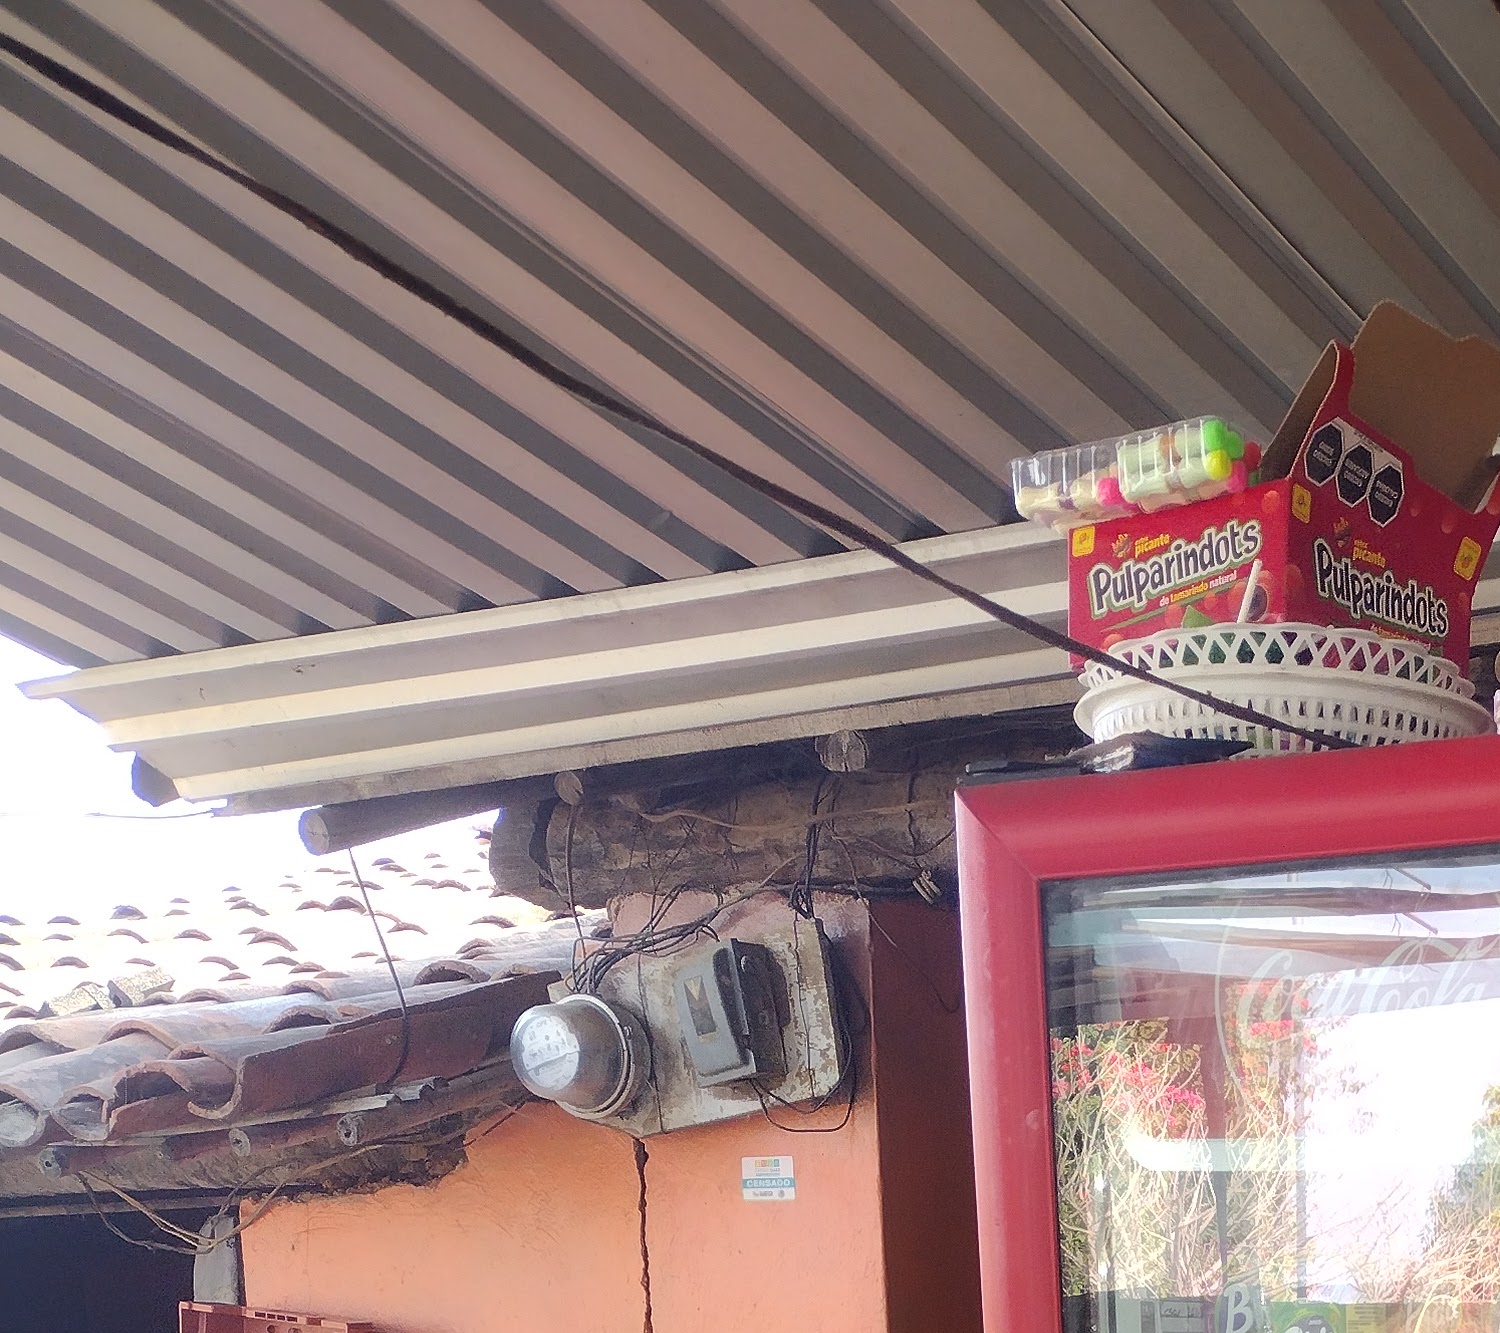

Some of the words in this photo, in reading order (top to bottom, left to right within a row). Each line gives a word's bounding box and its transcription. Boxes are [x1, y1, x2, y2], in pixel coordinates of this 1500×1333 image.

[1089, 520, 1262, 614] Pulparindots
[1313, 538, 1448, 638] Pulparindots
[746, 1178, 791, 1188] CENSADO
